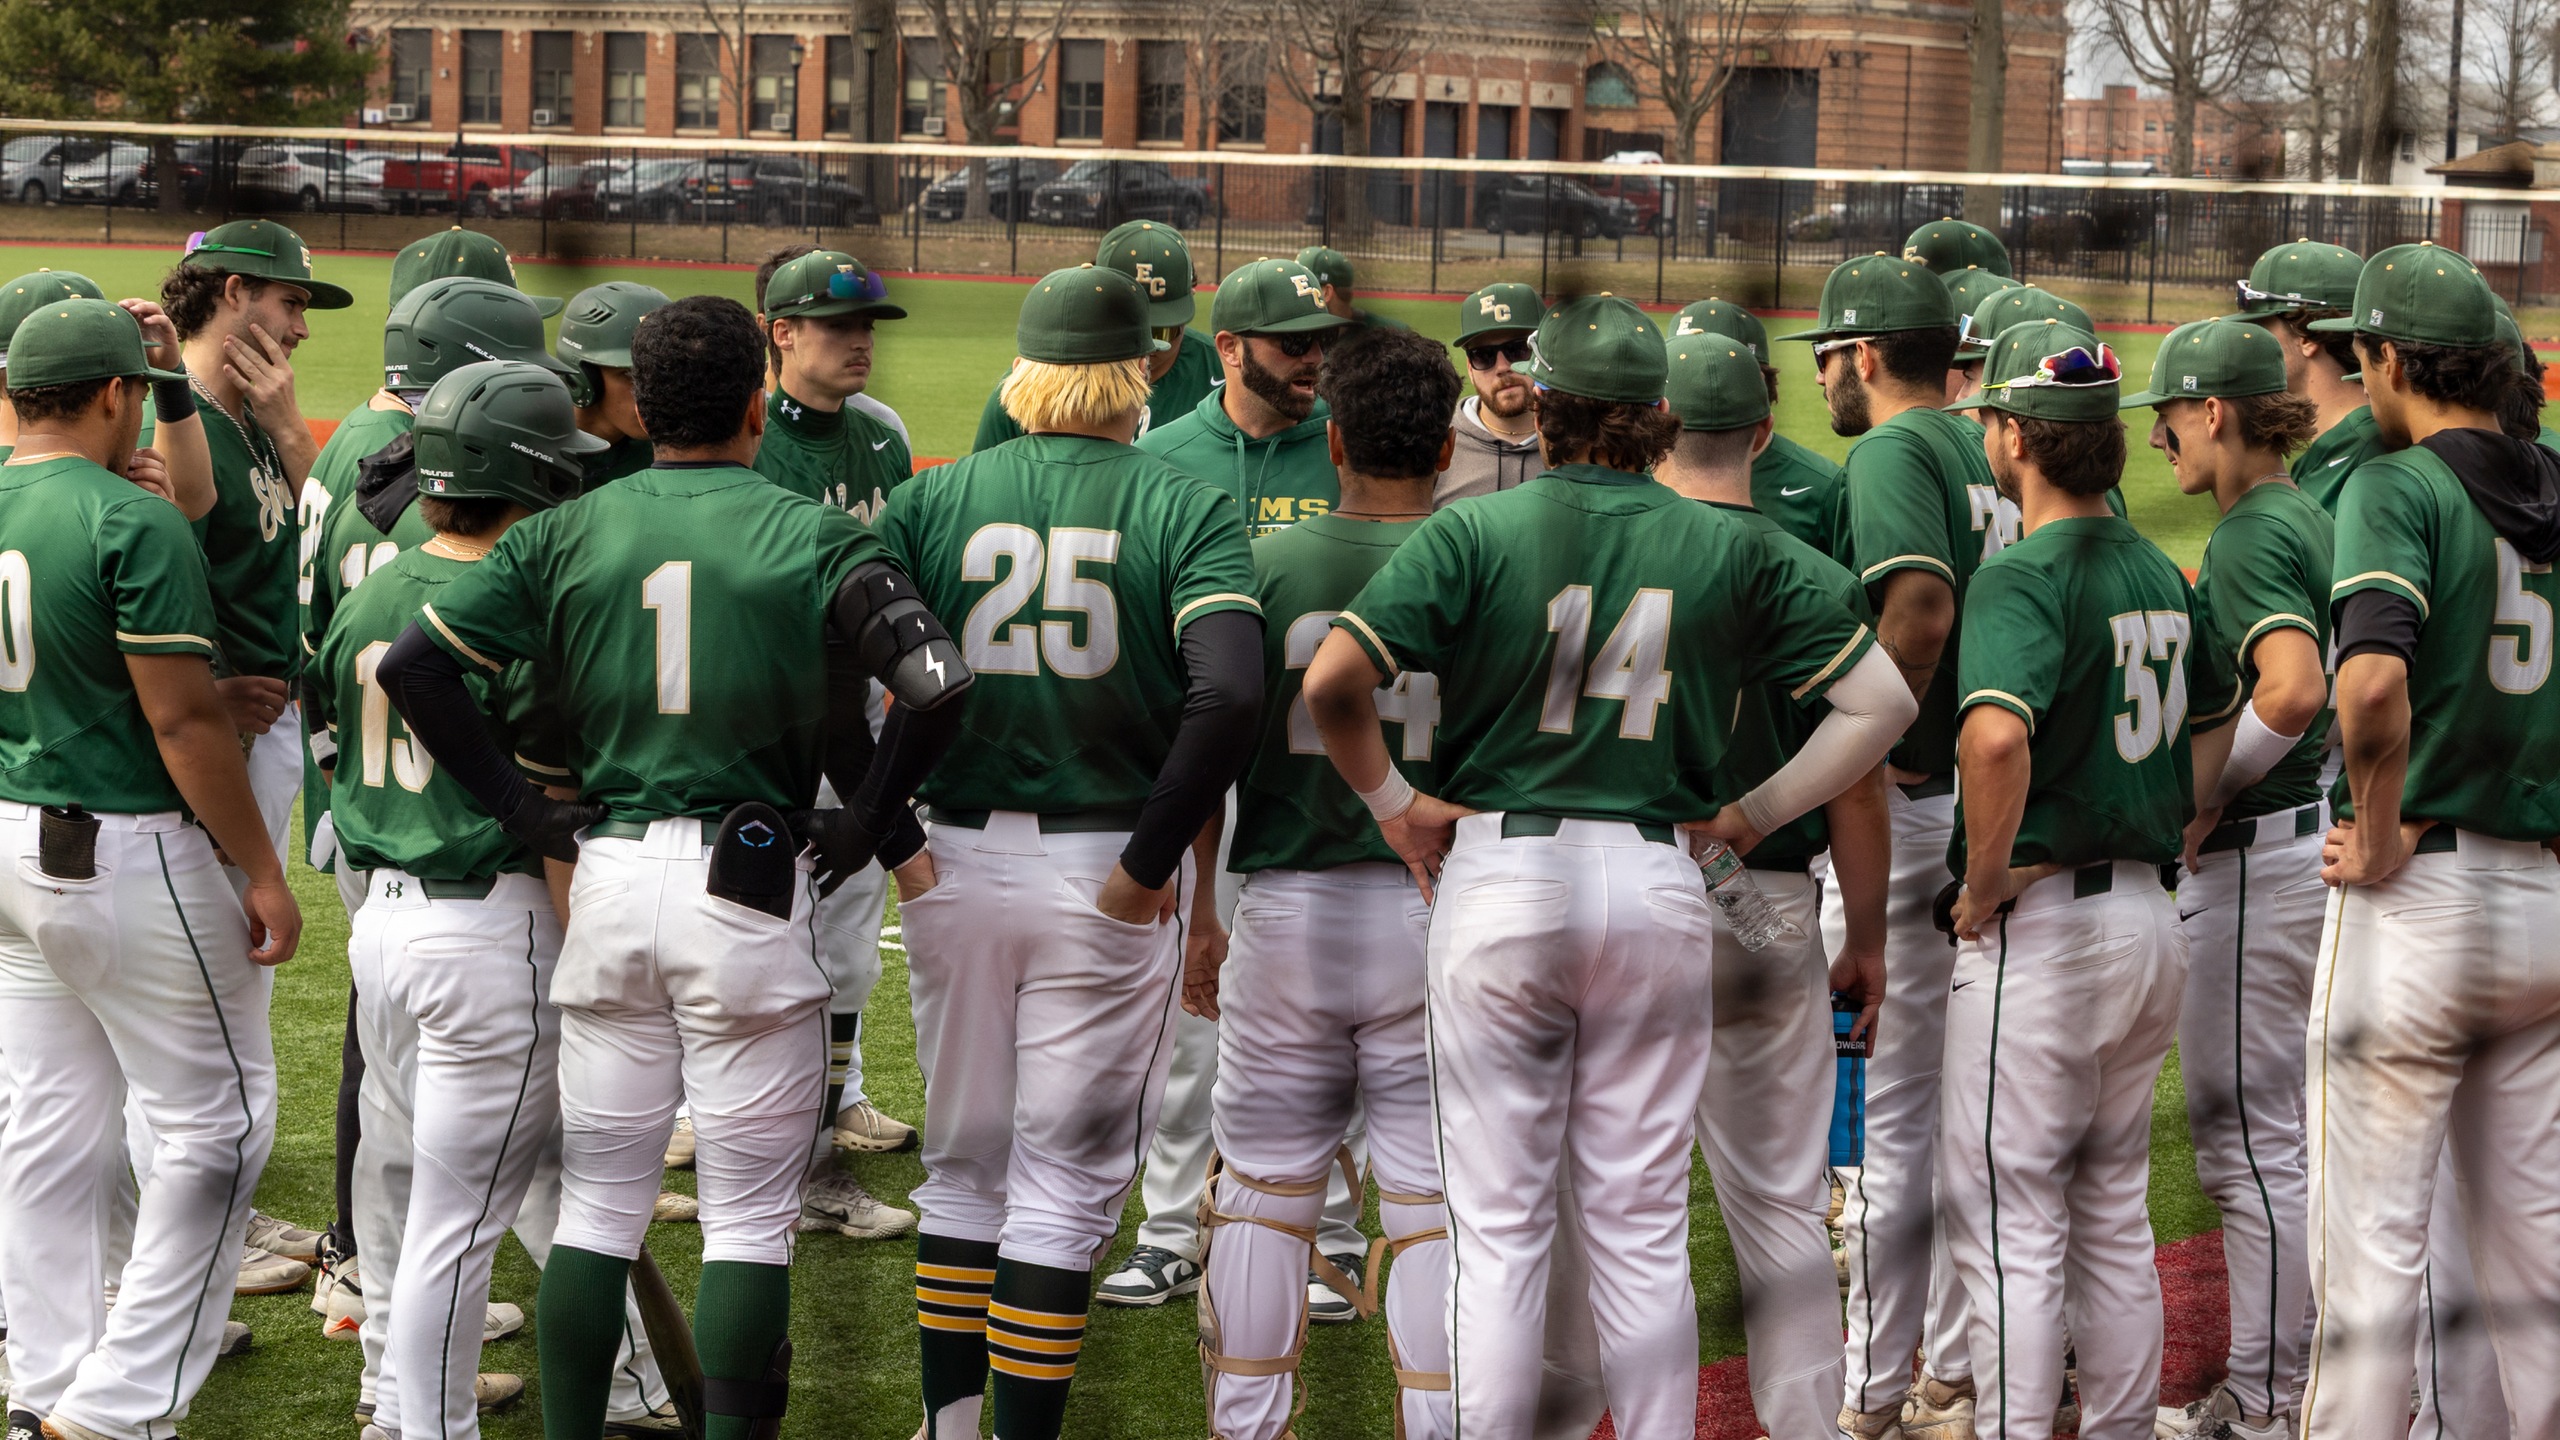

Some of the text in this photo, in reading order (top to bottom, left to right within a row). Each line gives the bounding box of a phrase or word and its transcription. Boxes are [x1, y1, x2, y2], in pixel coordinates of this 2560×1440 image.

[1136, 263, 1166, 297] EC
[1290, 274, 1325, 309] EC
[1480, 295, 1511, 322] EC
[1676, 316, 1704, 335] E
[510, 441, 554, 463] RAWLINGS
[1250, 497, 1329, 521] MS
[962, 522, 1120, 680] 25
[2487, 537, 2554, 695] 5
[642, 560, 692, 715] 1
[1538, 584, 1673, 741] 14
[2109, 610, 2190, 764] 37
